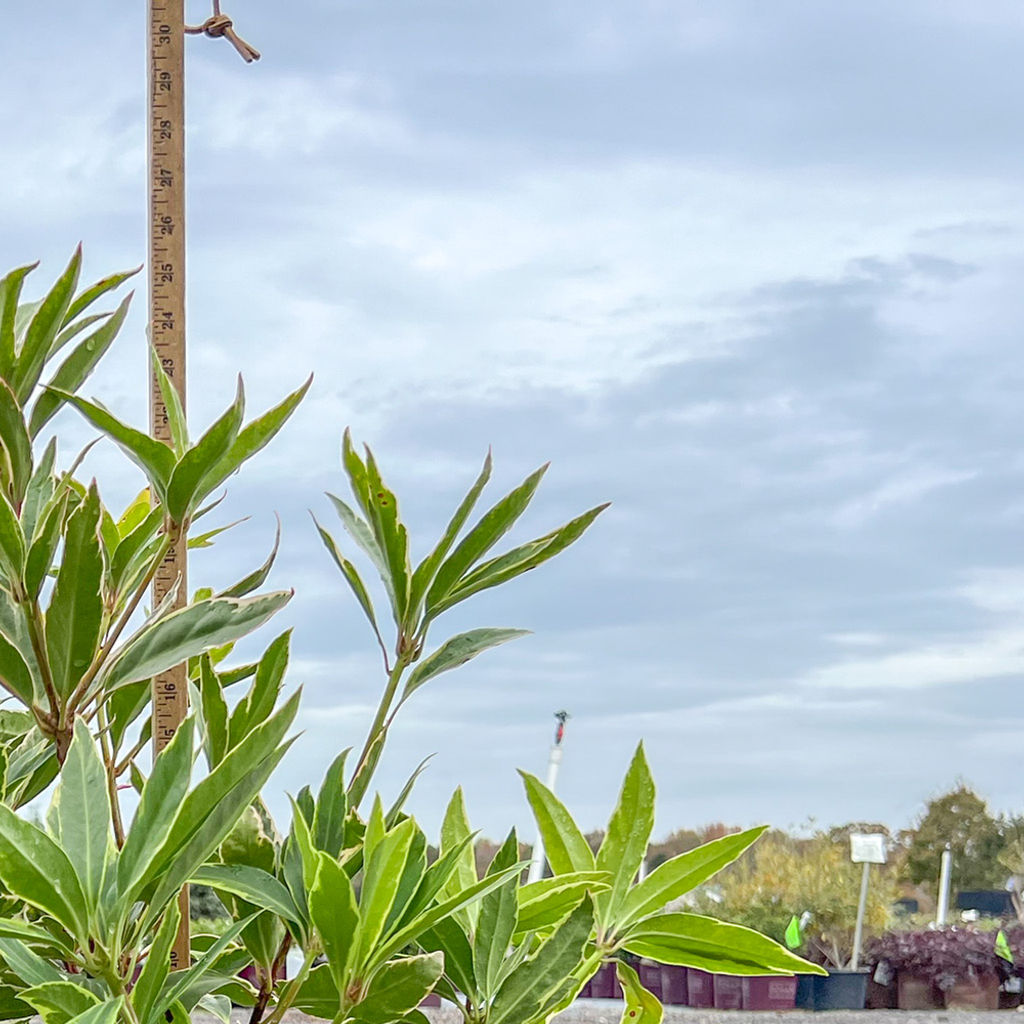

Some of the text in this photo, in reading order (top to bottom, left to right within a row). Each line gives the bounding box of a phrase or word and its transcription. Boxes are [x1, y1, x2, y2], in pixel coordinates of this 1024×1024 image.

[159, 24, 171, 44] 30
[160, 72, 171, 91] 29
[160, 120, 171, 140] 28
[160, 169, 172, 187] 27
[161, 216, 173, 235] 26
[161, 264, 173, 282] 25
[162, 312, 174, 330] 24
[165, 683, 176, 700] 16
